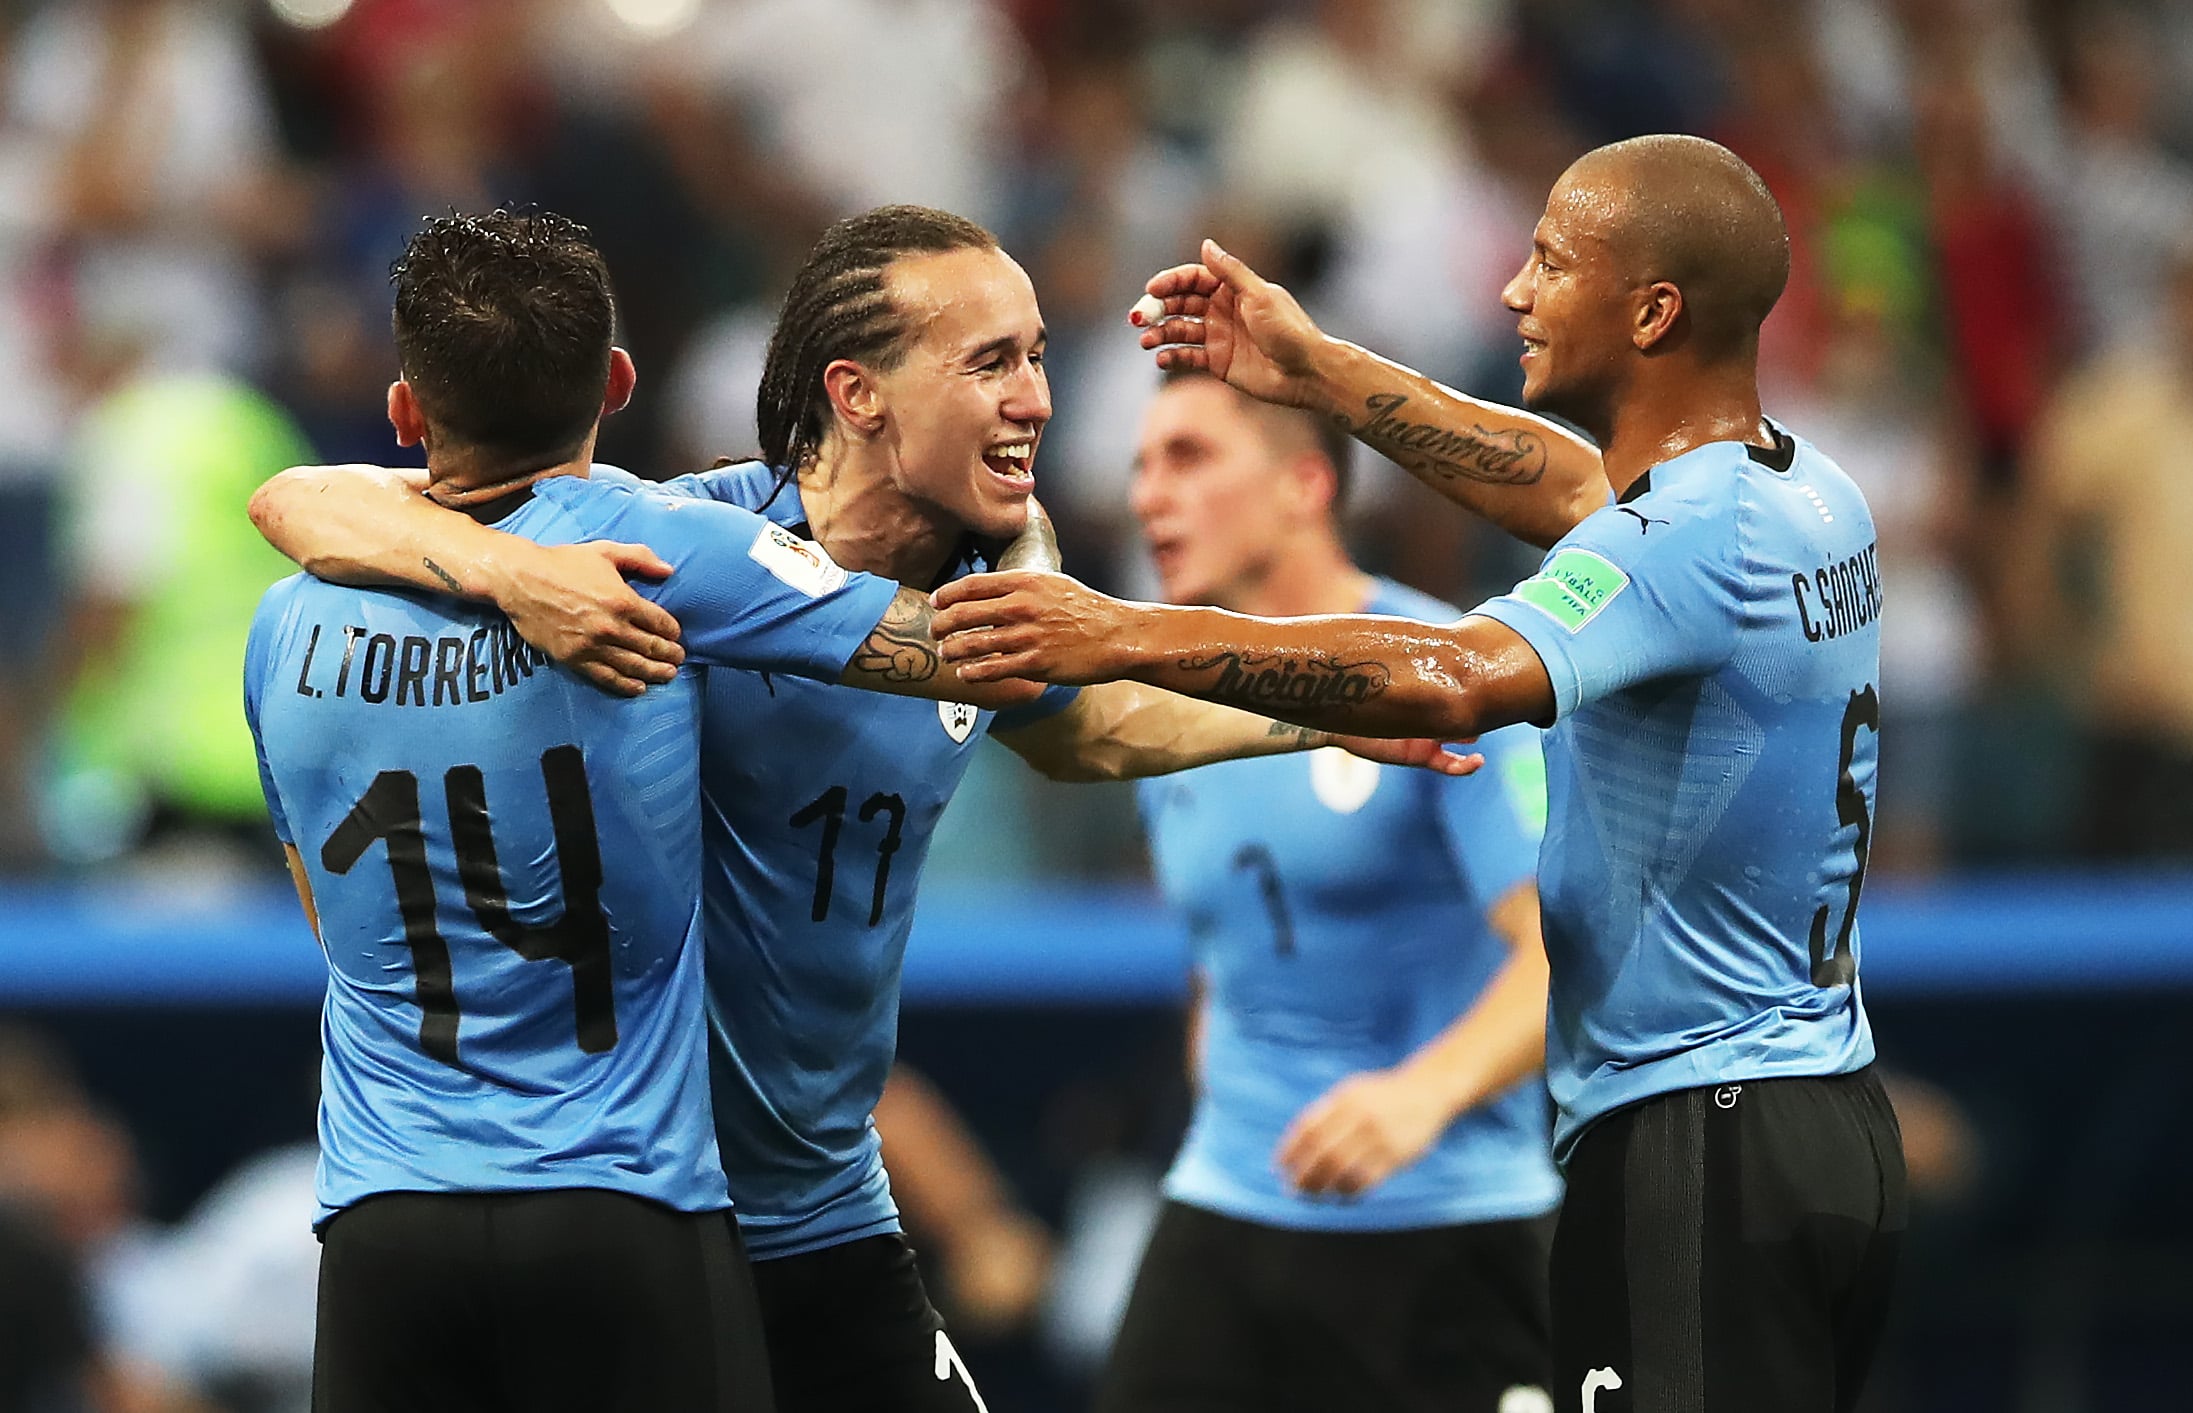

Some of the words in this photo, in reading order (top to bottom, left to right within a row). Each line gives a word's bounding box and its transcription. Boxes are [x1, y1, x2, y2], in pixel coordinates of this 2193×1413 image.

[1792, 542, 1882, 642] C.SÁNCHE
[296, 622, 548, 707] L.TORREIR
[320, 743, 619, 1069] 14
[789, 785, 906, 927] 17
